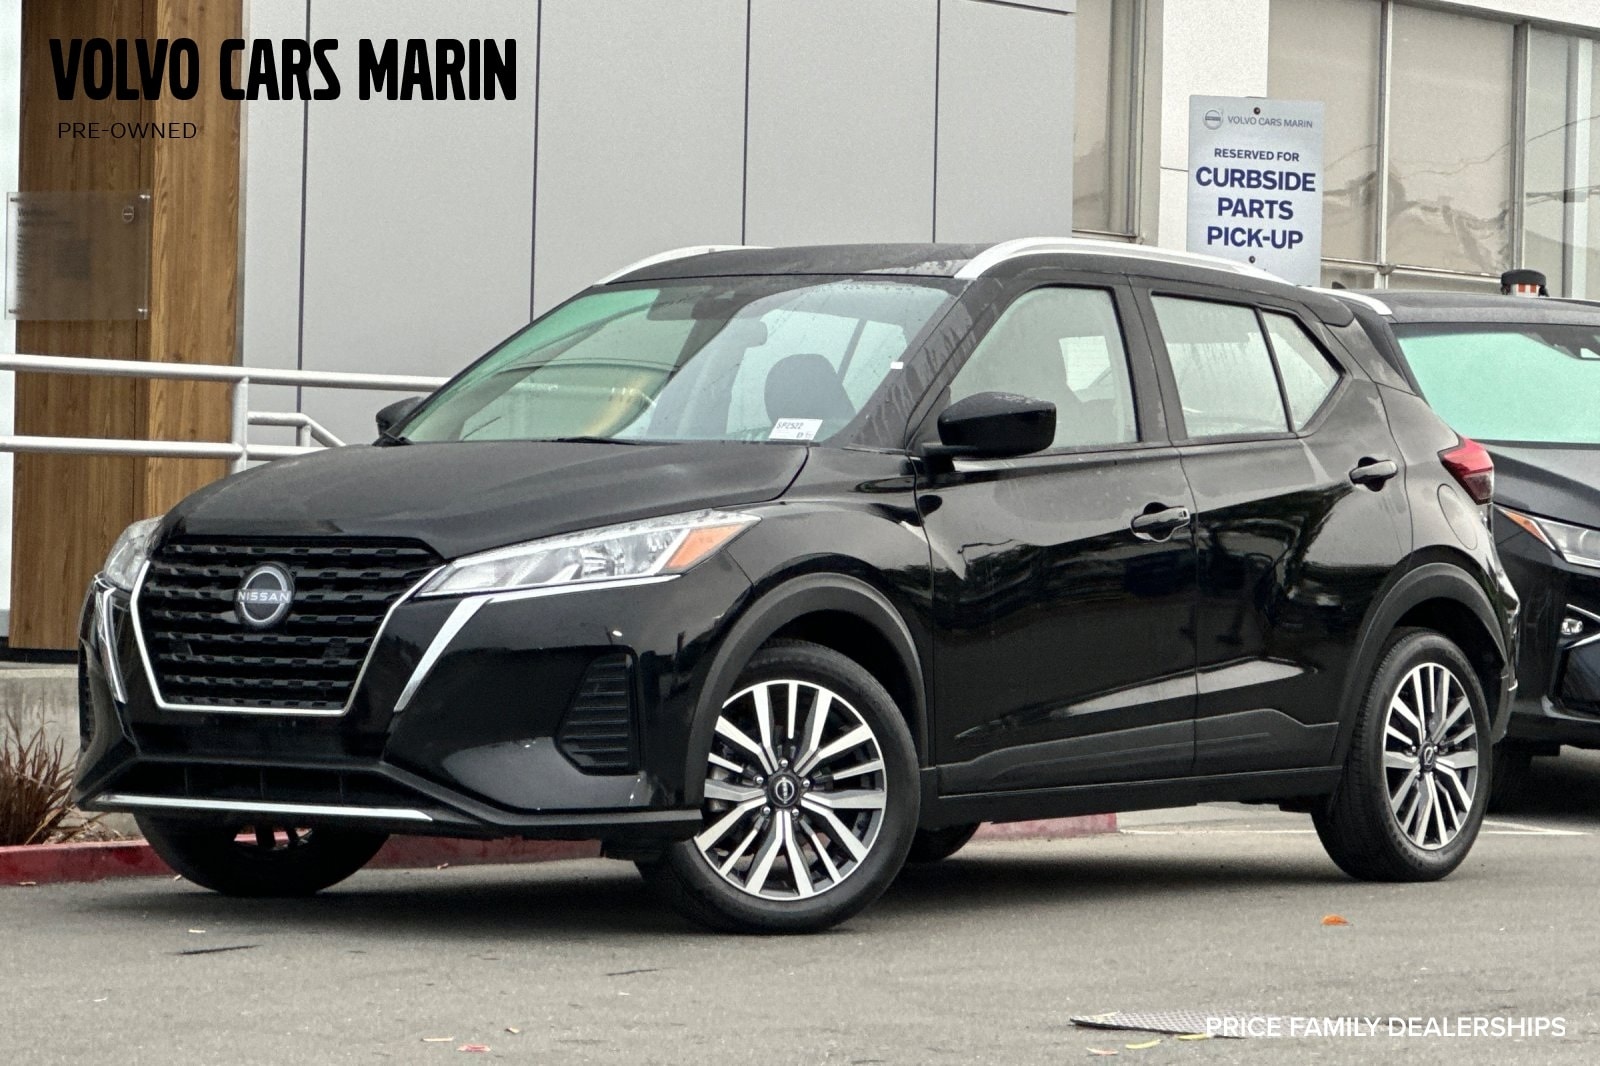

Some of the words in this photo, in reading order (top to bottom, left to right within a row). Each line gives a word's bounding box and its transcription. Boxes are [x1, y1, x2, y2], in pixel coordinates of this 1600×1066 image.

[1227, 115, 1257, 125] VOLVO
[1258, 117, 1281, 127] CARS
[1284, 119, 1313, 128] MARIN
[1214, 148, 1274, 160] RESERVED
[1277, 151, 1300, 162] FOR
[1195, 166, 1316, 192] CURBSIDE
[1217, 197, 1294, 220] PARTS
[1207, 225, 1304, 250] PICK-UP
[238, 591, 290, 601] NISSAN
